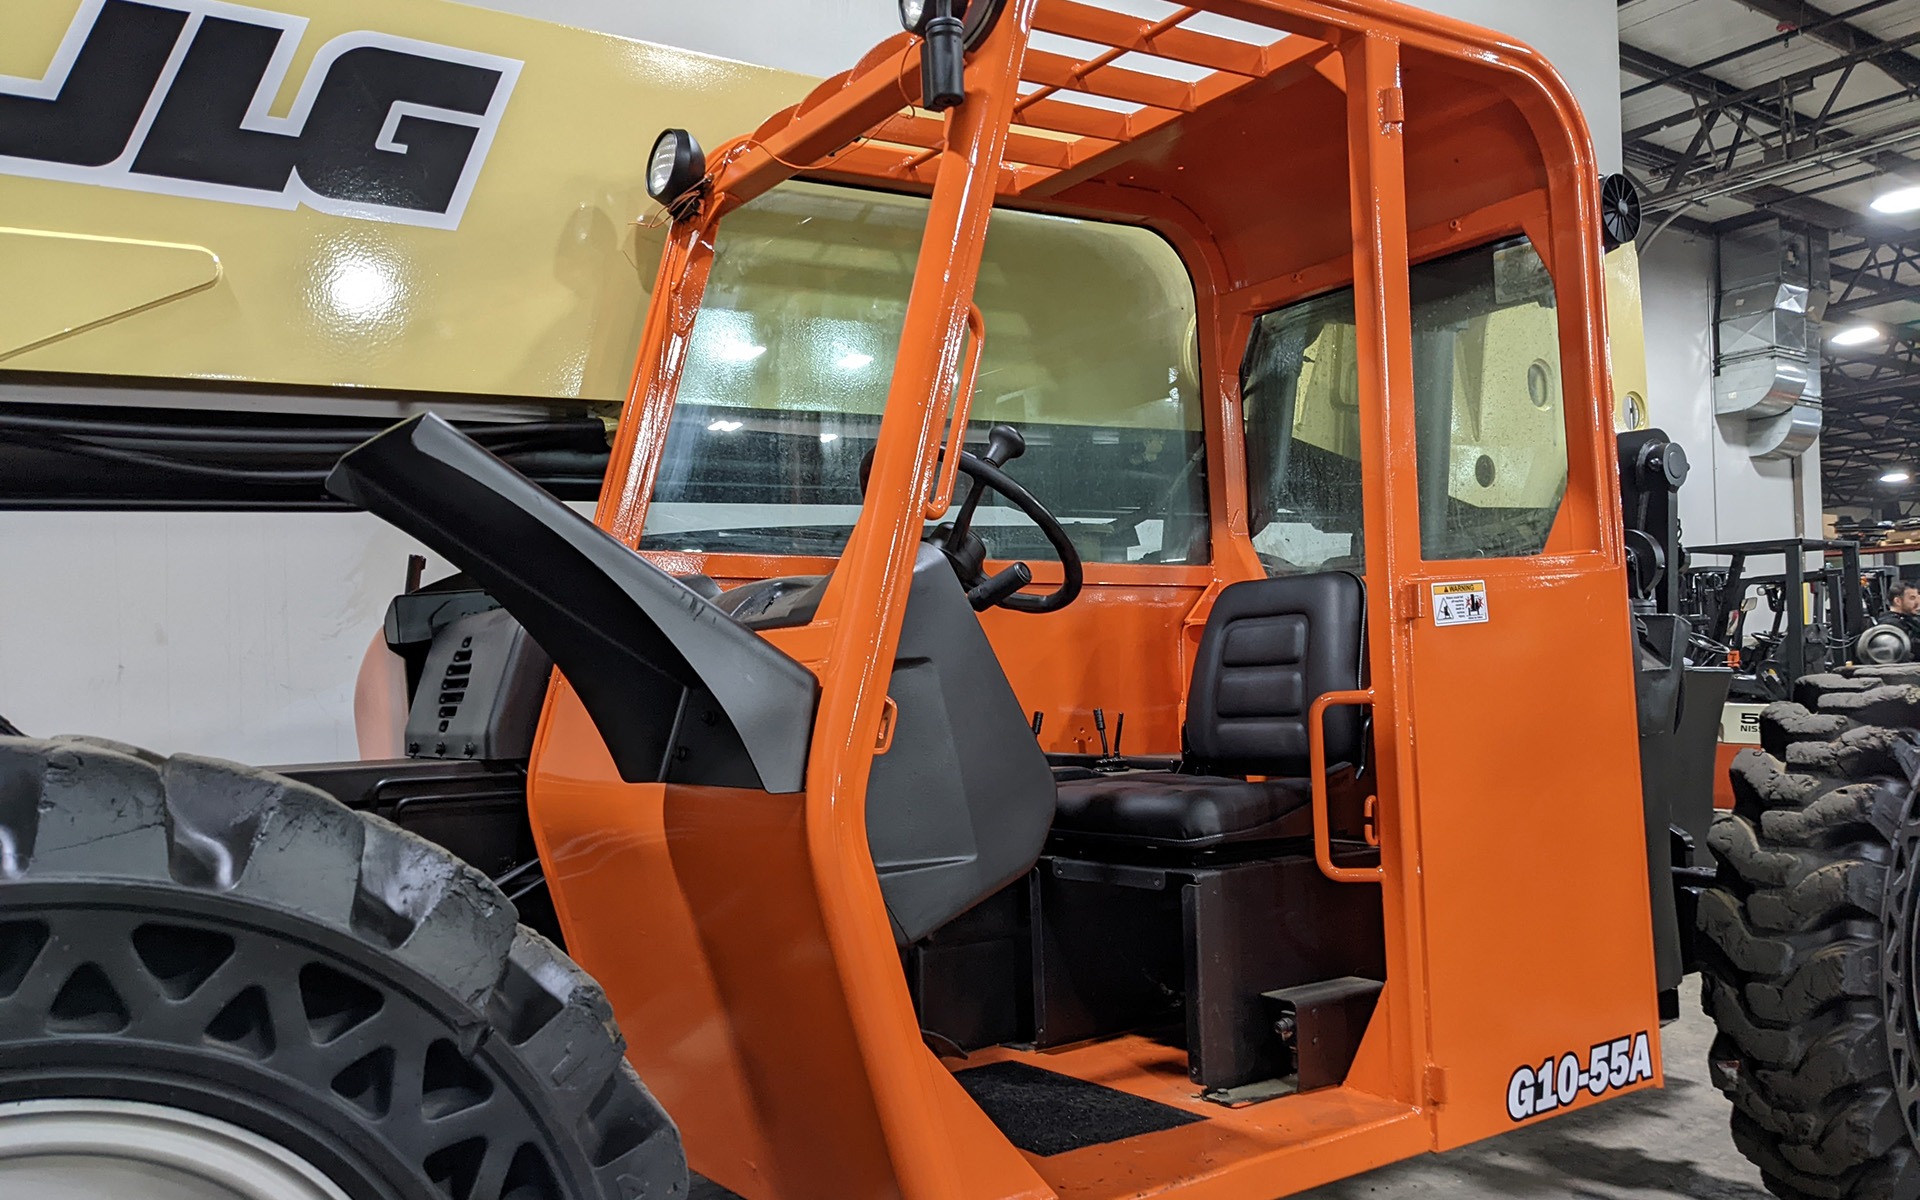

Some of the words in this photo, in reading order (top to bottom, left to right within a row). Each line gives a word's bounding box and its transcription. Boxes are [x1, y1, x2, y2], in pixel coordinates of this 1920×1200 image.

[0, 0, 520, 226] JLG
[1449, 584, 1474, 592] WARNING
[1740, 712, 1760, 724] 5
[1506, 1030, 1653, 1122] G10-55A
